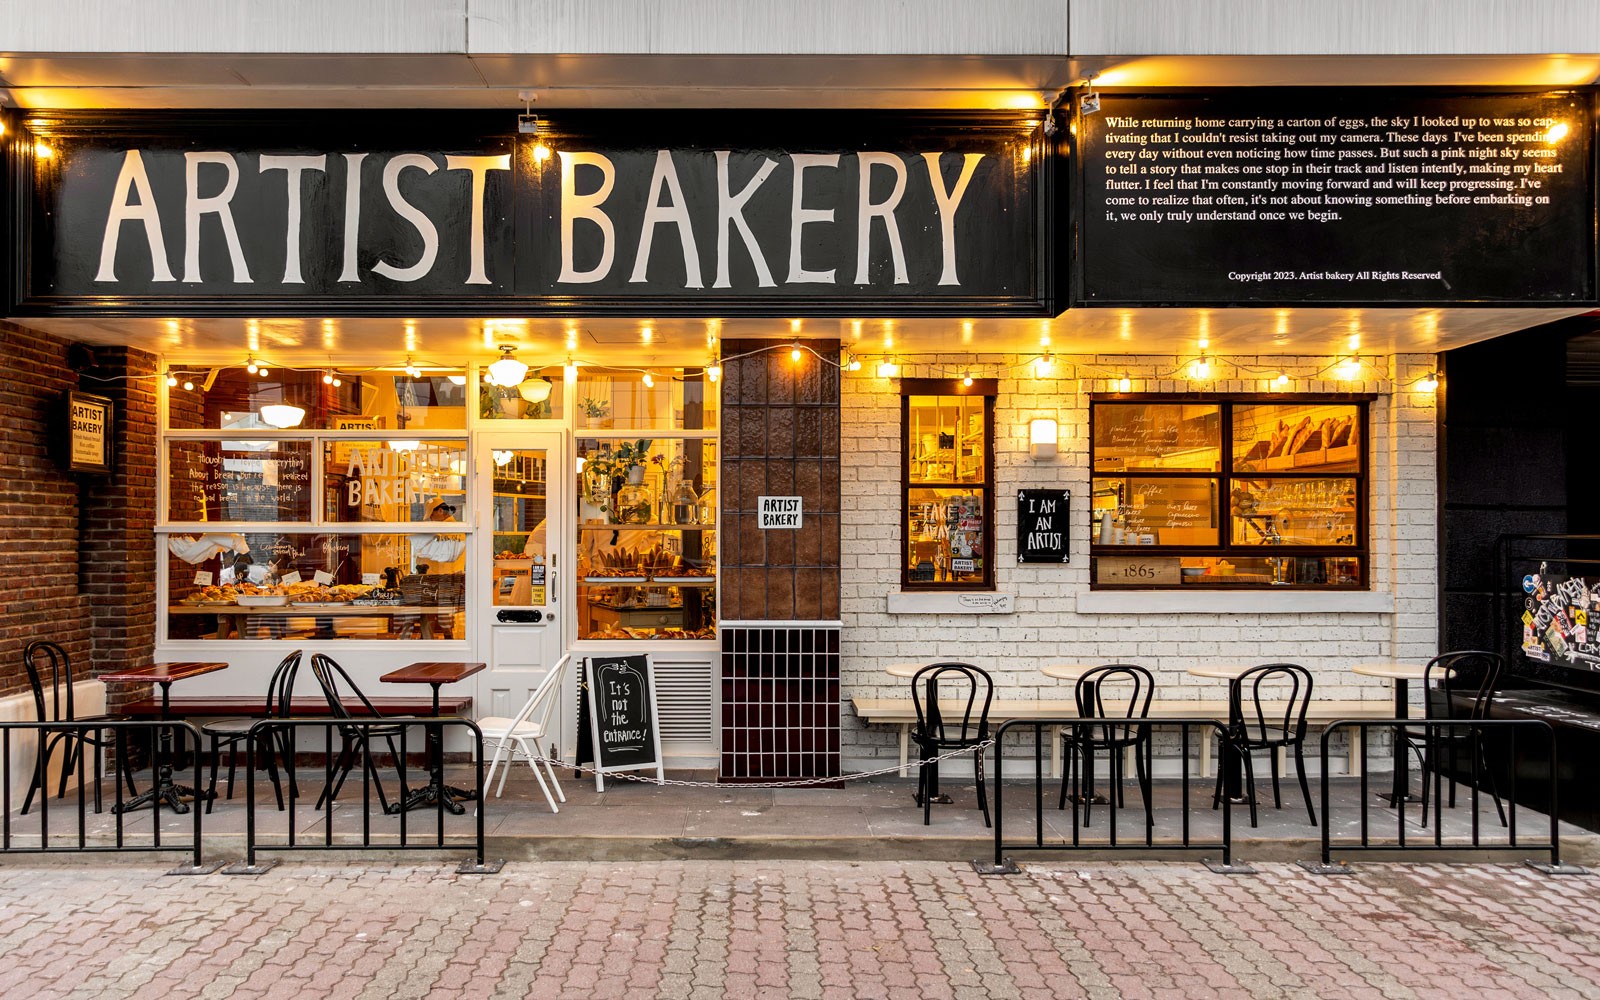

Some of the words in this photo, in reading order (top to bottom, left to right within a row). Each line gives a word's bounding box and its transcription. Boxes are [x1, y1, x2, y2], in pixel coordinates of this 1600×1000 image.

[1106, 117, 1139, 127] While
[1141, 117, 1191, 130] returning
[1195, 117, 1225, 128] home
[1228, 117, 1274, 129] carrying
[1286, 119, 1320, 127] carton
[1323, 117, 1336, 127] of
[1338, 120, 1367, 130] eggs,
[1370, 117, 1387, 127] the
[1390, 117, 1409, 129] sky
[1413, 117, 1417, 127] I
[1421, 117, 1458, 127] looked
[1461, 119, 1476, 130] up
[1478, 118, 1490, 127] to
[1492, 119, 1515, 127] was
[1517, 118, 1531, 127] so
[1532, 118, 1557, 129] cap-
[1104, 133, 1147, 145] tivating
[1150, 133, 1171, 144] that
[1174, 133, 1179, 143] I
[1181, 133, 1226, 143] couldn't
[1229, 133, 1258, 143] resist
[1261, 133, 1295, 145] taking
[1298, 134, 1316, 143] out
[1319, 135, 1336, 145] my
[1340, 135, 1383, 143] camera.
[1385, 132, 1418, 143] These
[1421, 132, 1447, 144] days
[1454, 132, 1474, 143] I've
[1477, 132, 1504, 143] been
[1104, 151, 1136, 162] every
[1138, 148, 1158, 161] day
[1161, 148, 1203, 159] without
[1206, 151, 1232, 159] even
[1235, 148, 1280, 160] noticing
[1284, 148, 1307, 158] how
[1310, 148, 1334, 159] time
[1338, 151, 1376, 161] passes.
[1379, 148, 1399, 158] But
[1402, 148, 1428, 158] such
[1431, 150, 1438, 158] a
[1440, 147, 1465, 160] pink
[1468, 147, 1497, 160] night
[1499, 147, 1520, 160] sky
[1522, 150, 1557, 158] seems
[1105, 165, 1116, 175] to
[1119, 164, 1137, 175] tell
[1140, 167, 1147, 175] a
[1149, 165, 1177, 177] story
[1180, 164, 1201, 174] that
[1204, 164, 1239, 174] makes
[1242, 166, 1262, 174] one
[1265, 165, 1288, 177] stop
[1291, 164, 1302, 174] in
[1305, 164, 1331, 174] their
[1334, 163, 1361, 174] track
[1364, 163, 1384, 174] and
[1388, 163, 1418, 174] listen
[1421, 163, 1466, 175] intently,
[1469, 163, 1510, 175] making
[1513, 165, 1531, 176] my
[1533, 163, 1563, 174] heart
[1105, 179, 1142, 190] flutter.
[1144, 180, 1150, 190] I
[1153, 179, 1173, 190] feel
[1176, 180, 1197, 190] that
[1200, 179, 1219, 190] I'm
[1221, 179, 1278, 191] constantly
[1281, 179, 1323, 191] moving
[1326, 179, 1369, 190] forward
[1372, 179, 1392, 189] and
[1395, 179, 1417, 189] will
[1420, 179, 1446, 191] keep
[1449, 178, 1517, 191] progressing.
[1519, 178, 1541, 189] I've
[1105, 198, 1135, 206] come
[1137, 197, 1149, 206] to
[1152, 195, 1188, 206] realize
[1191, 195, 1213, 205] that
[1215, 195, 1248, 207] often,
[1250, 195, 1266, 205] it's
[1269, 196, 1287, 205] not
[1290, 195, 1321, 205] about
[1324, 194, 1372, 207] knowing
[1375, 194, 1432, 206] something
[1435, 194, 1471, 205] before
[1473, 193, 1532, 206] embarking
[1534, 196, 1549, 205] on
[94, 149, 512, 284] ARTIST
[557, 150, 986, 289] BAKERY
[1105, 211, 1117, 223] it,
[1120, 213, 1136, 221] we
[1139, 211, 1163, 223] only
[1166, 210, 1192, 223] truly
[1196, 210, 1255, 221] understand
[1259, 213, 1285, 221] once
[1288, 213, 1304, 221] we
[1307, 210, 1341, 222] begin.
[1227, 272, 1271, 283] Copyright
[1273, 272, 1297, 280] 2023.
[1298, 272, 1323, 280] Artist
[1325, 272, 1354, 282] bakery
[1355, 272, 1369, 280] All
[1371, 272, 1399, 282] Rights
[1401, 271, 1441, 280] Reserved
[72, 406, 102, 421] ARTIST
[72, 421, 102, 434] BAKERY
[347, 448, 424, 478] ARTIST
[283, 472, 308, 481] realized
[206, 483, 228, 491] reason
[347, 478, 425, 506] BAKERY
[1138, 484, 1164, 496] Coffee
[764, 499, 799, 512] ARTIST
[921, 502, 954, 521] TAKE
[1029, 499, 1035, 513] I
[1040, 499, 1056, 514] AM
[764, 514, 798, 526] BAKERY
[1036, 516, 1052, 531] AN
[921, 524, 951, 540] AWAY
[1028, 532, 1062, 550] ARTIST
[1124, 564, 1155, 578] 1865
[610, 681, 630, 695] It's
[612, 699, 628, 711] not
[611, 711, 629, 726] the
